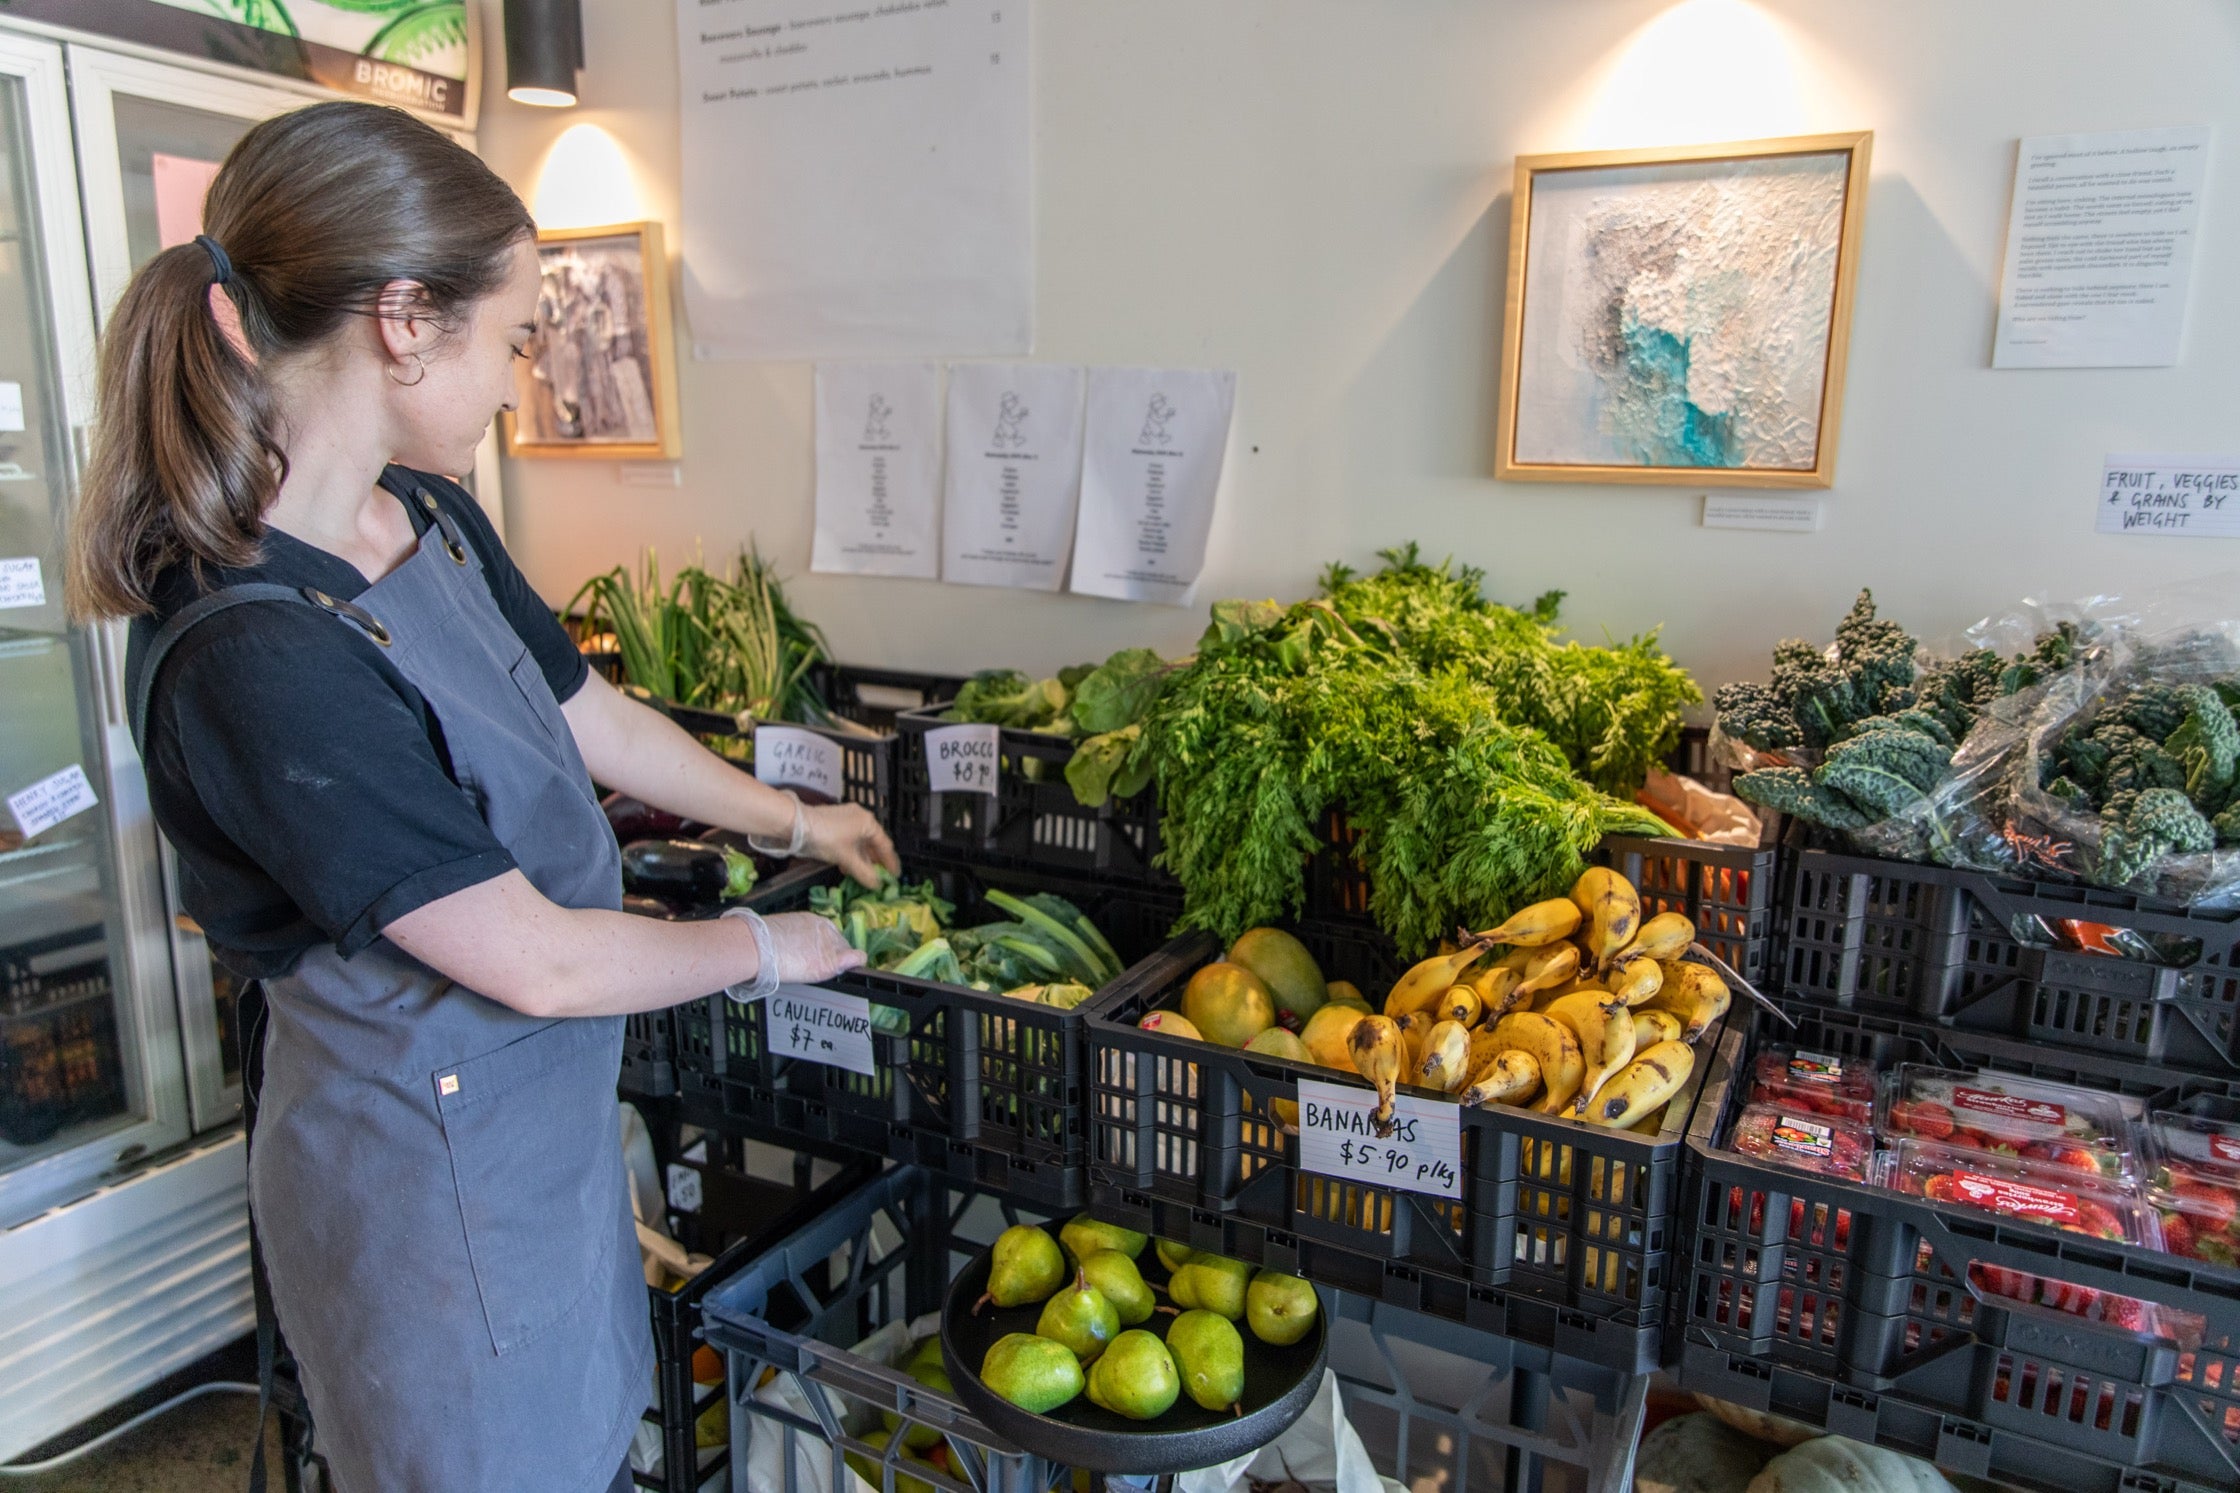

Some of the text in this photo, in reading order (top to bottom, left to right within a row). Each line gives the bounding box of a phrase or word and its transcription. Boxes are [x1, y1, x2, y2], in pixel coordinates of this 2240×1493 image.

[355, 58, 448, 103] BROMIC
[2173, 472, 2239, 493] VEGGIES
[2106, 490, 2227, 510] & GRAINS BY
[2123, 510, 2191, 530] WEIGHT
[772, 740, 826, 765] GARLIC
[773, 998, 873, 1042] CAULIFLOWER
[790, 1023, 814, 1052] $7
[1340, 1139, 1455, 1189] $5.90 p/kg
